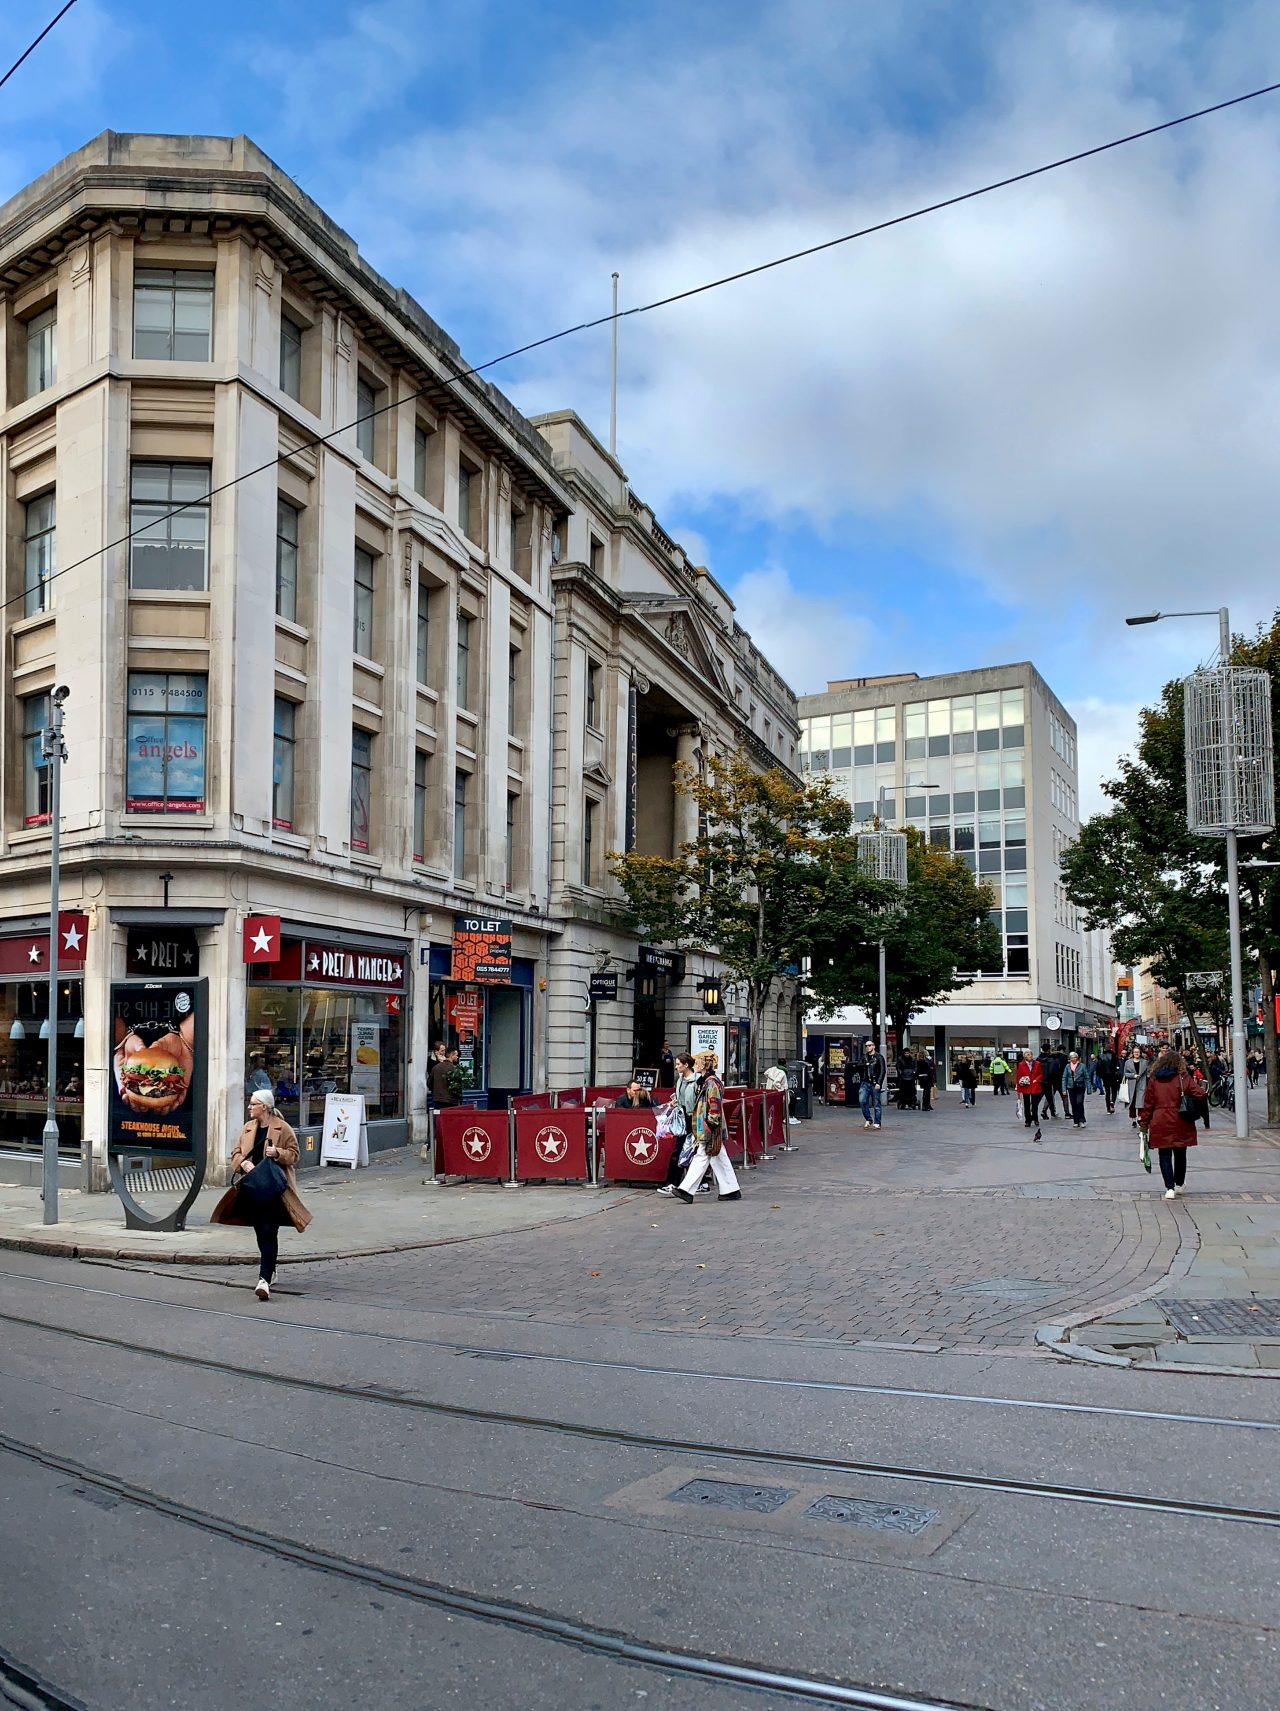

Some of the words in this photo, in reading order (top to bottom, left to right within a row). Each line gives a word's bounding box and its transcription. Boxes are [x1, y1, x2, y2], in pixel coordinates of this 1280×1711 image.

[131, 688, 154, 696] 0115
[138, 740, 198, 762] angels
[464, 919, 479, 931] TO
[480, 921, 501, 932] LET
[151, 940, 179, 968] PRET
[322, 951, 345, 978] PRET
[348, 955, 355, 979] A
[358, 956, 393, 982] MANGER
[457, 993, 466, 1005] TO
[466, 994, 478, 1006] LET
[121, 1121, 160, 1132] STEAKHOUSE
